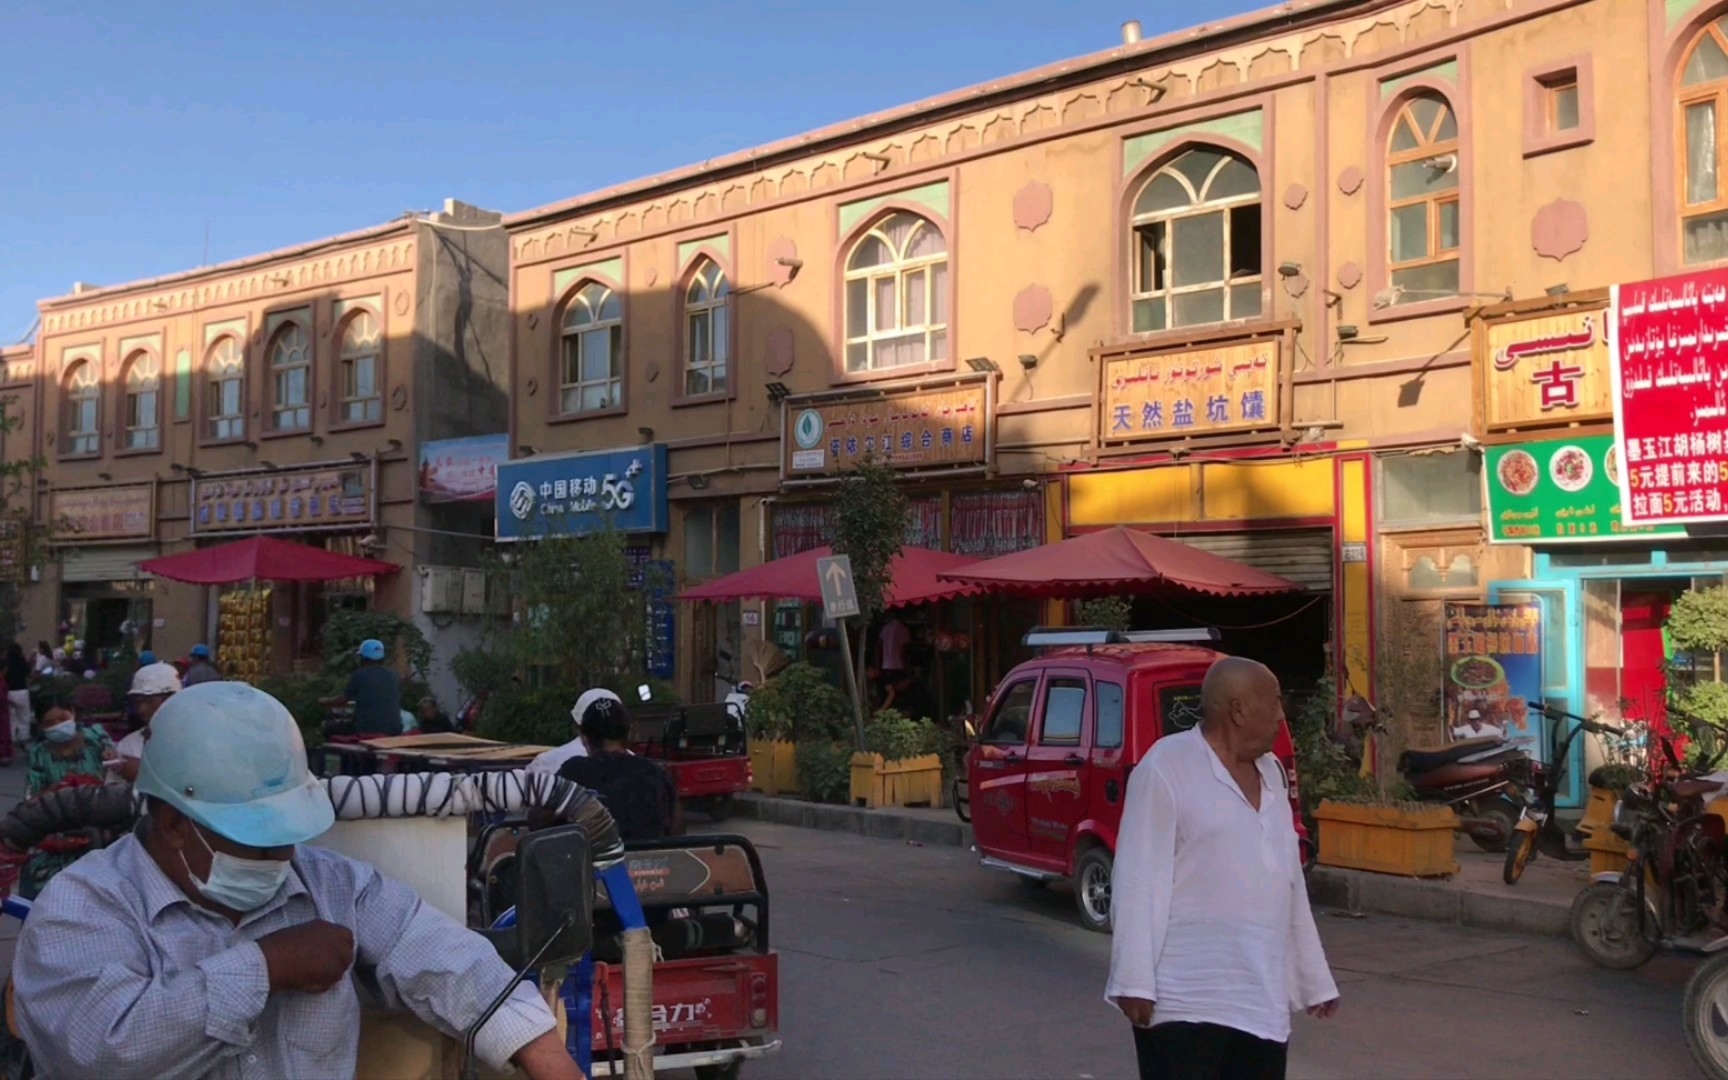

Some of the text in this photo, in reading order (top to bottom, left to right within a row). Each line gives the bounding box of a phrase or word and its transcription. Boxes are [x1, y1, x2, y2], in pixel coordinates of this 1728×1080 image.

[1112, 390, 1266, 433] 天然盐坑馕
[539, 476, 598, 500] 中国移动
